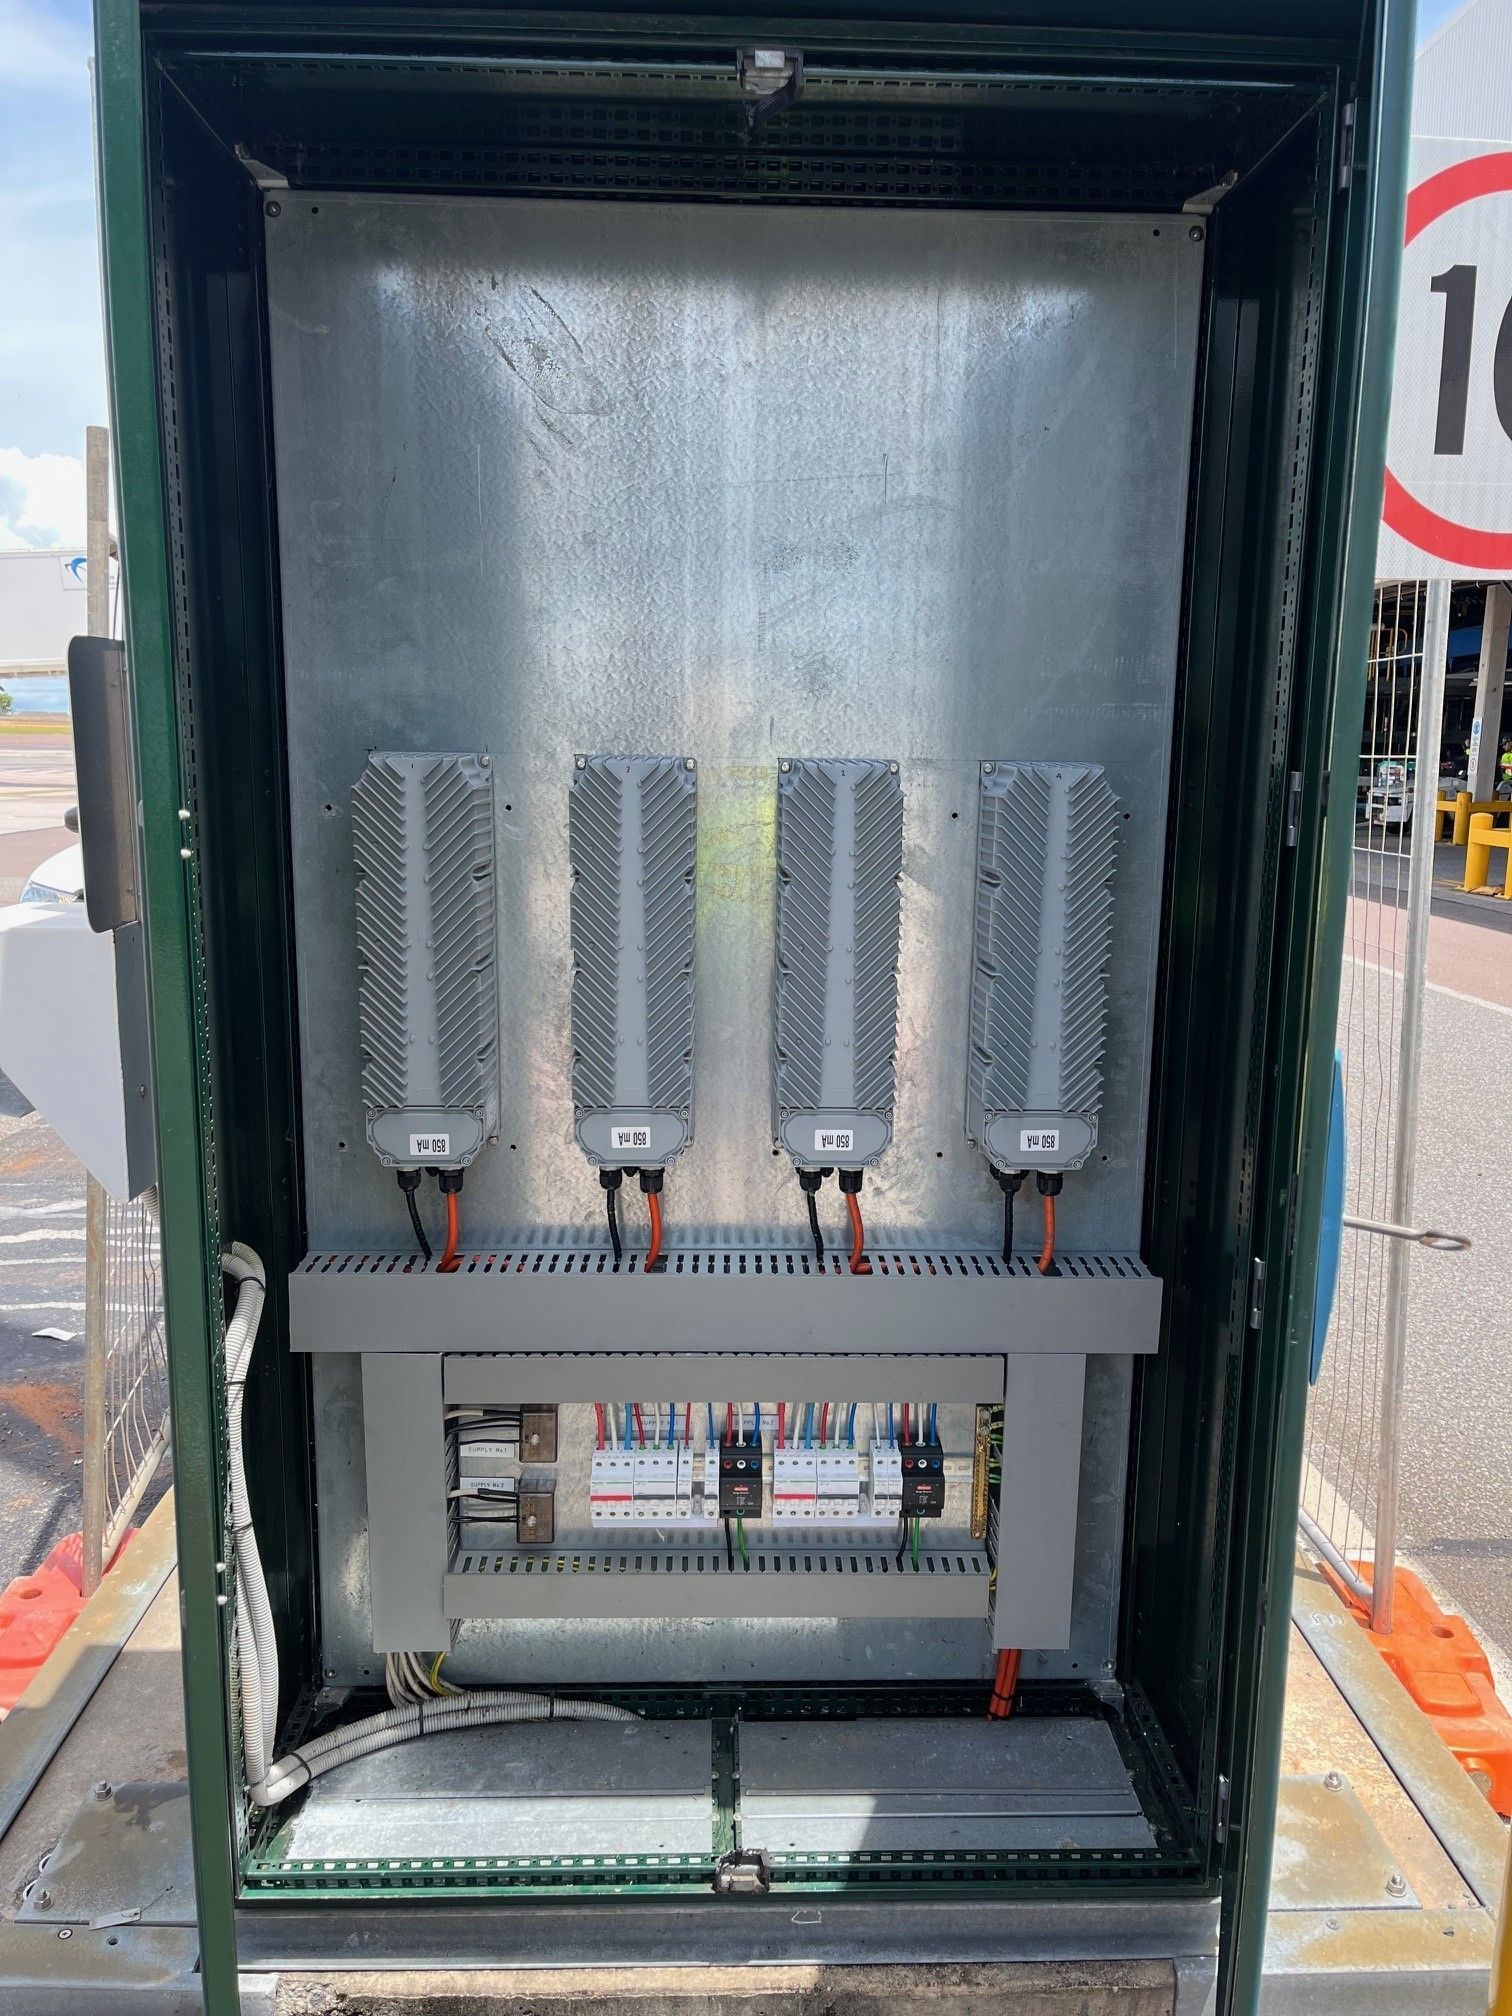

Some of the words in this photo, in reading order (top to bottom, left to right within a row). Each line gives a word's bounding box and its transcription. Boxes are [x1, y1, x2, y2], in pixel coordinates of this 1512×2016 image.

[1430, 264, 1512, 456] 1
[416, 1139, 430, 1153] mA
[432, 1139, 446, 1153] 850
[618, 1132, 631, 1146] mA
[633, 1132, 647, 1146] 850
[821, 1135, 834, 1148] mA
[836, 1135, 850, 1148] 850
[1027, 1135, 1040, 1149] mA
[1041, 1135, 1055, 1148] 850
